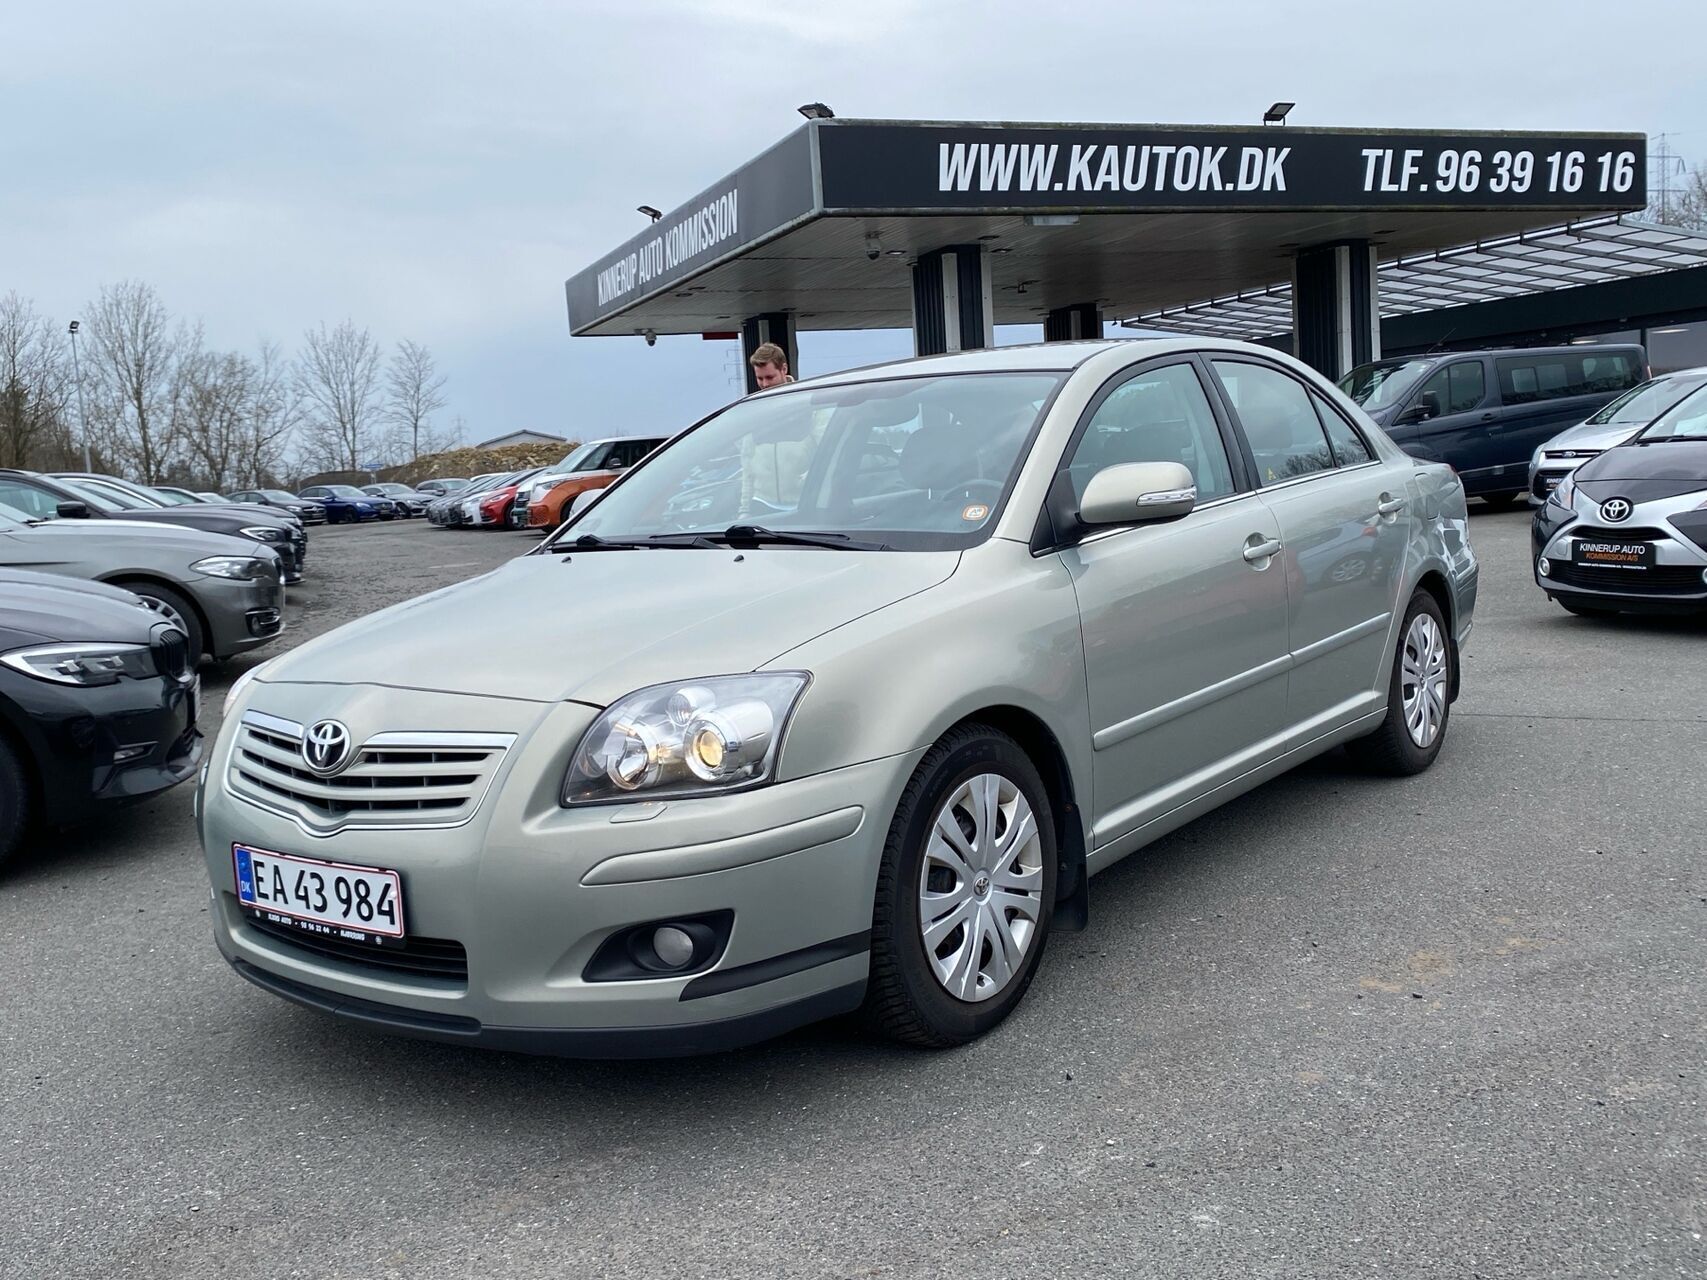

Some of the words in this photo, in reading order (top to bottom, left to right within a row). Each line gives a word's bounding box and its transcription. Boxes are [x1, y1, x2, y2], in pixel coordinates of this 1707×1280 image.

[938, 143, 1291, 192] WWW.KAUTOK.DK
[1361, 148, 1429, 192] TLF.
[1436, 149, 1482, 193] 96
[1489, 150, 1535, 193] 39
[1546, 151, 1585, 193] 16
[1597, 151, 1635, 193] 16
[597, 252, 638, 307] KINNERUP
[638, 236, 663, 285] AUTO
[665, 188, 738, 271] KOMMISSION
[1579, 543, 1621, 553] KINNERUP
[1621, 545, 1646, 555] AUTO
[1585, 552, 1626, 561] KOMMISSION
[240, 880, 252, 894] DK
[252, 859, 289, 905] EA
[294, 869, 328, 914] 43
[334, 875, 396, 926] 984
